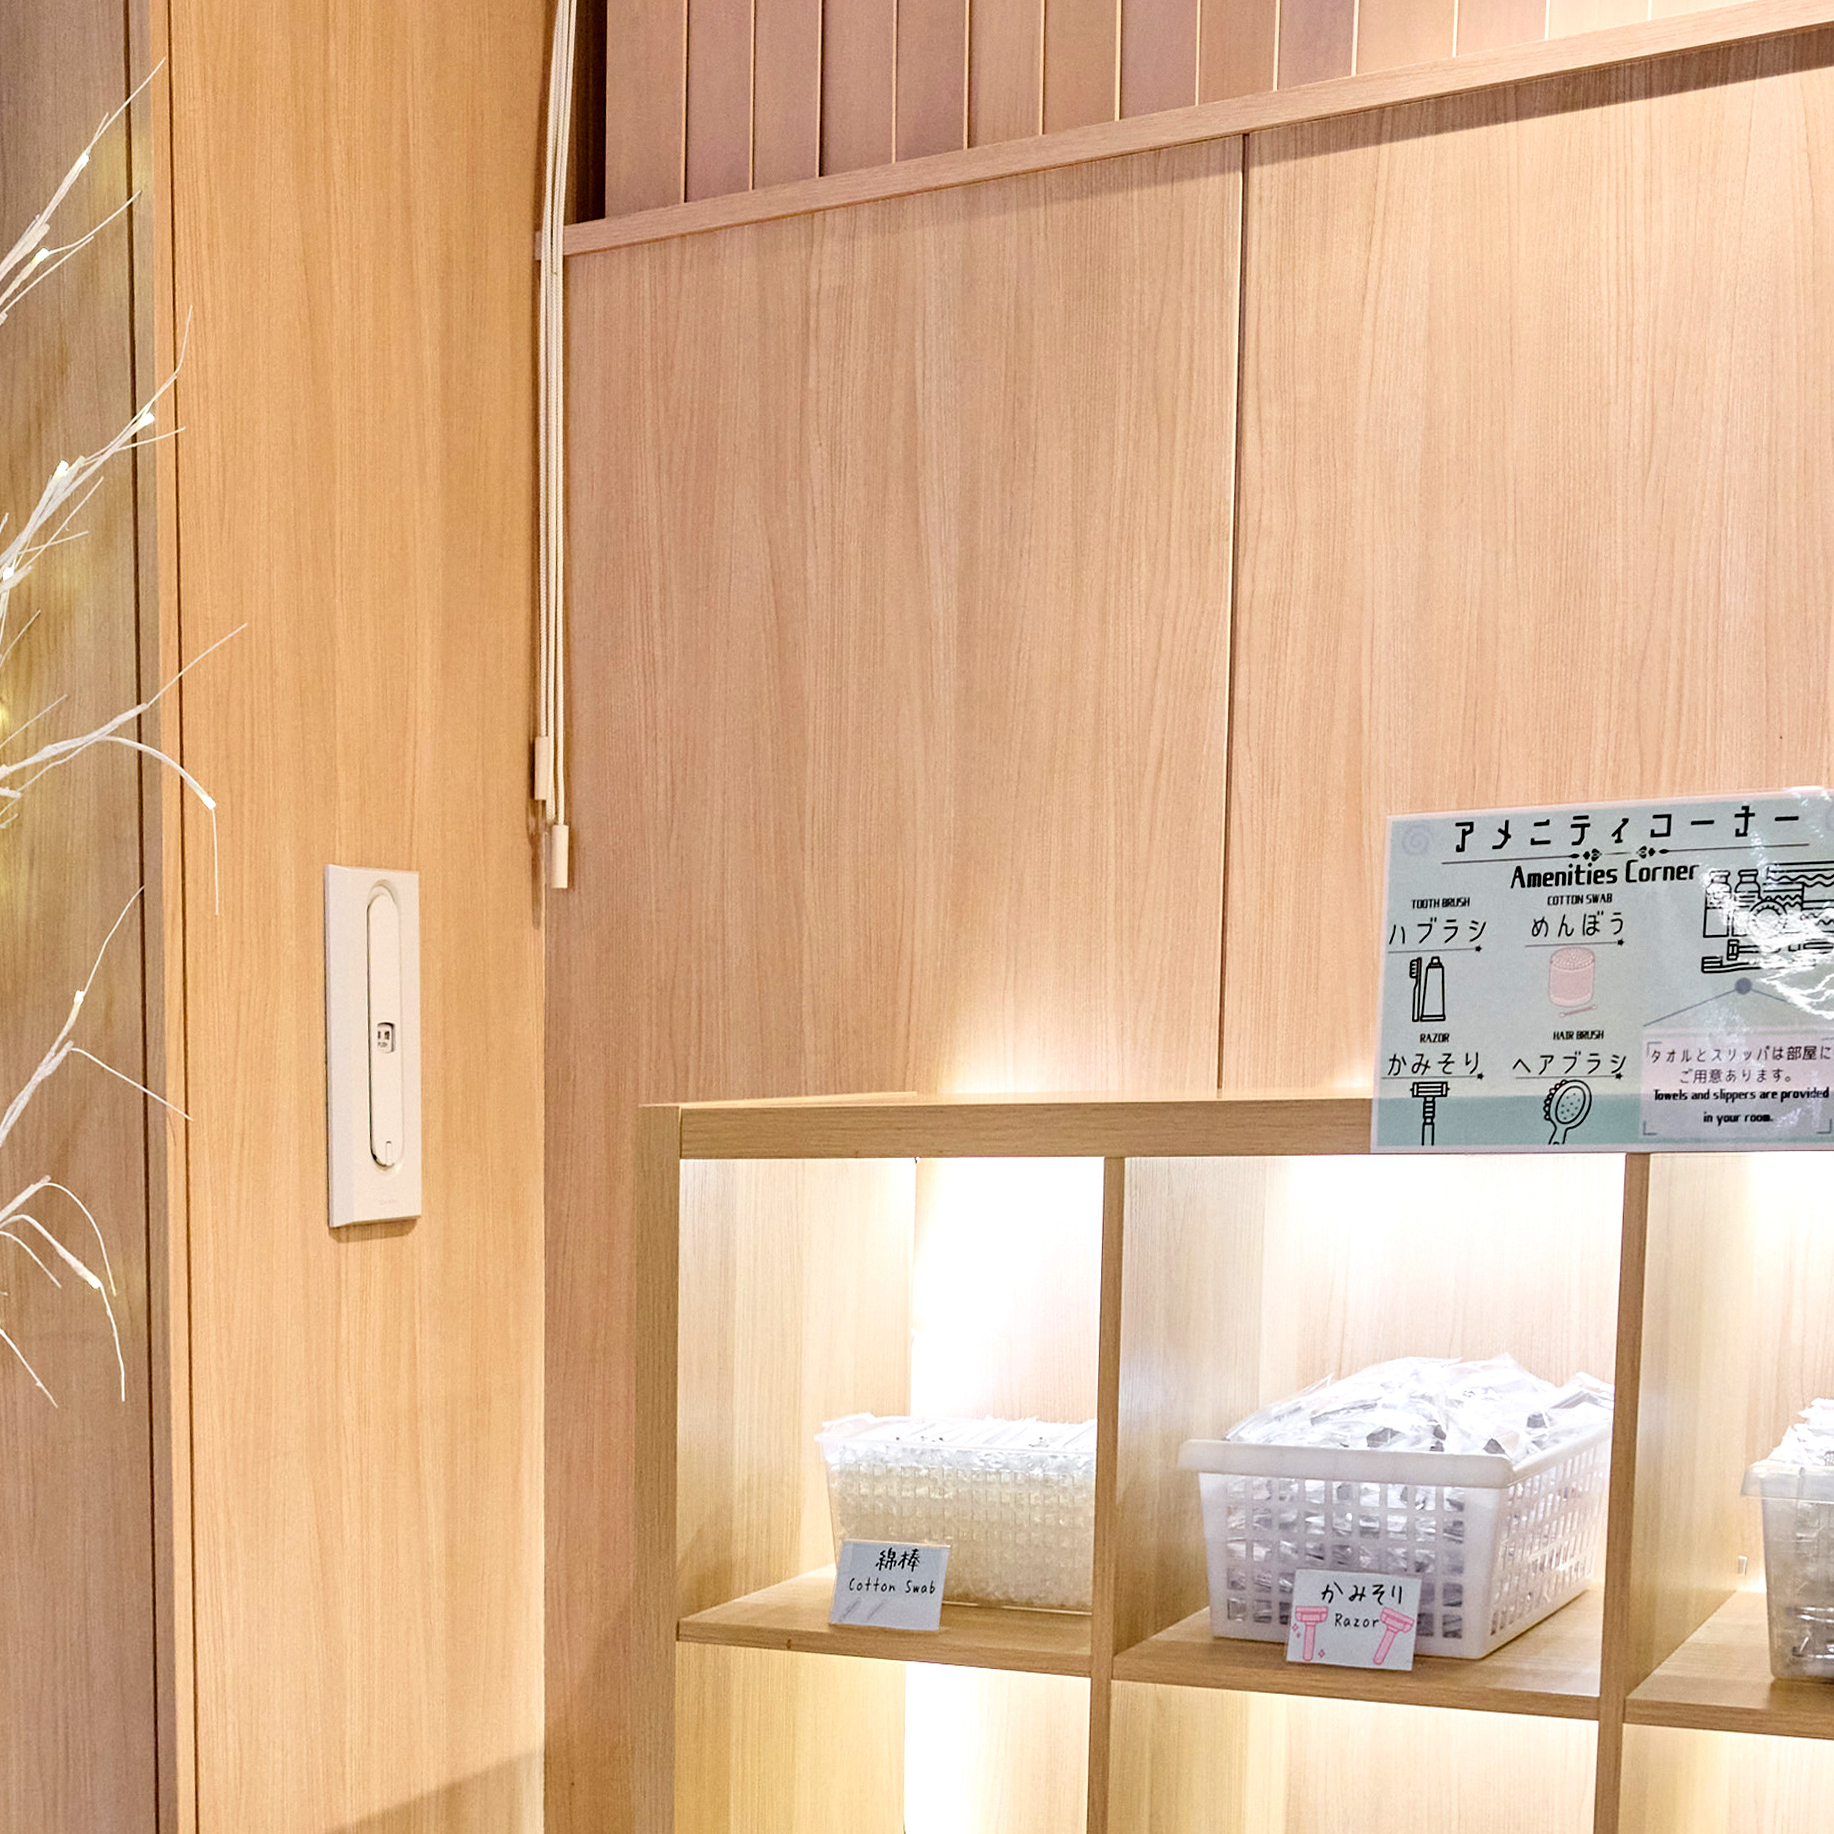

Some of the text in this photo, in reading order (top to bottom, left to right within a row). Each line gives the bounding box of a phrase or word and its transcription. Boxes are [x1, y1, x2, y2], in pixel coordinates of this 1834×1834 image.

[1455, 806, 1800, 852] アメニティコーナー
[1511, 861, 1700, 890] Amenities Corner
[1412, 897, 1470, 910] TOOTH BRUSH
[1547, 894, 1613, 906] COTTON SWAB
[1389, 920, 1487, 946] ハブラシ
[1531, 911, 1624, 938] めんぼう
[1419, 1034, 1450, 1044] RAZOR
[1553, 1030, 1604, 1042] HAIR BRUSH
[1651, 1045, 1833, 1064] タオルとスリッパは部屋に
[1388, 1051, 1480, 1077] かみそり
[1512, 1053, 1627, 1076] ヘアブラシ
[1679, 1069, 1792, 1084] ご用意あります。
[1654, 1086, 1830, 1103] Towels and slippers are provided
[1703, 1111, 1713, 1122] in
[1716, 1114, 1741, 1126] your
[874, 1547, 921, 1572] 綿棒
[848, 1577, 936, 1595] Cotton Swab
[1321, 1582, 1405, 1606] かみそり
[1334, 1611, 1381, 1629] Razor
